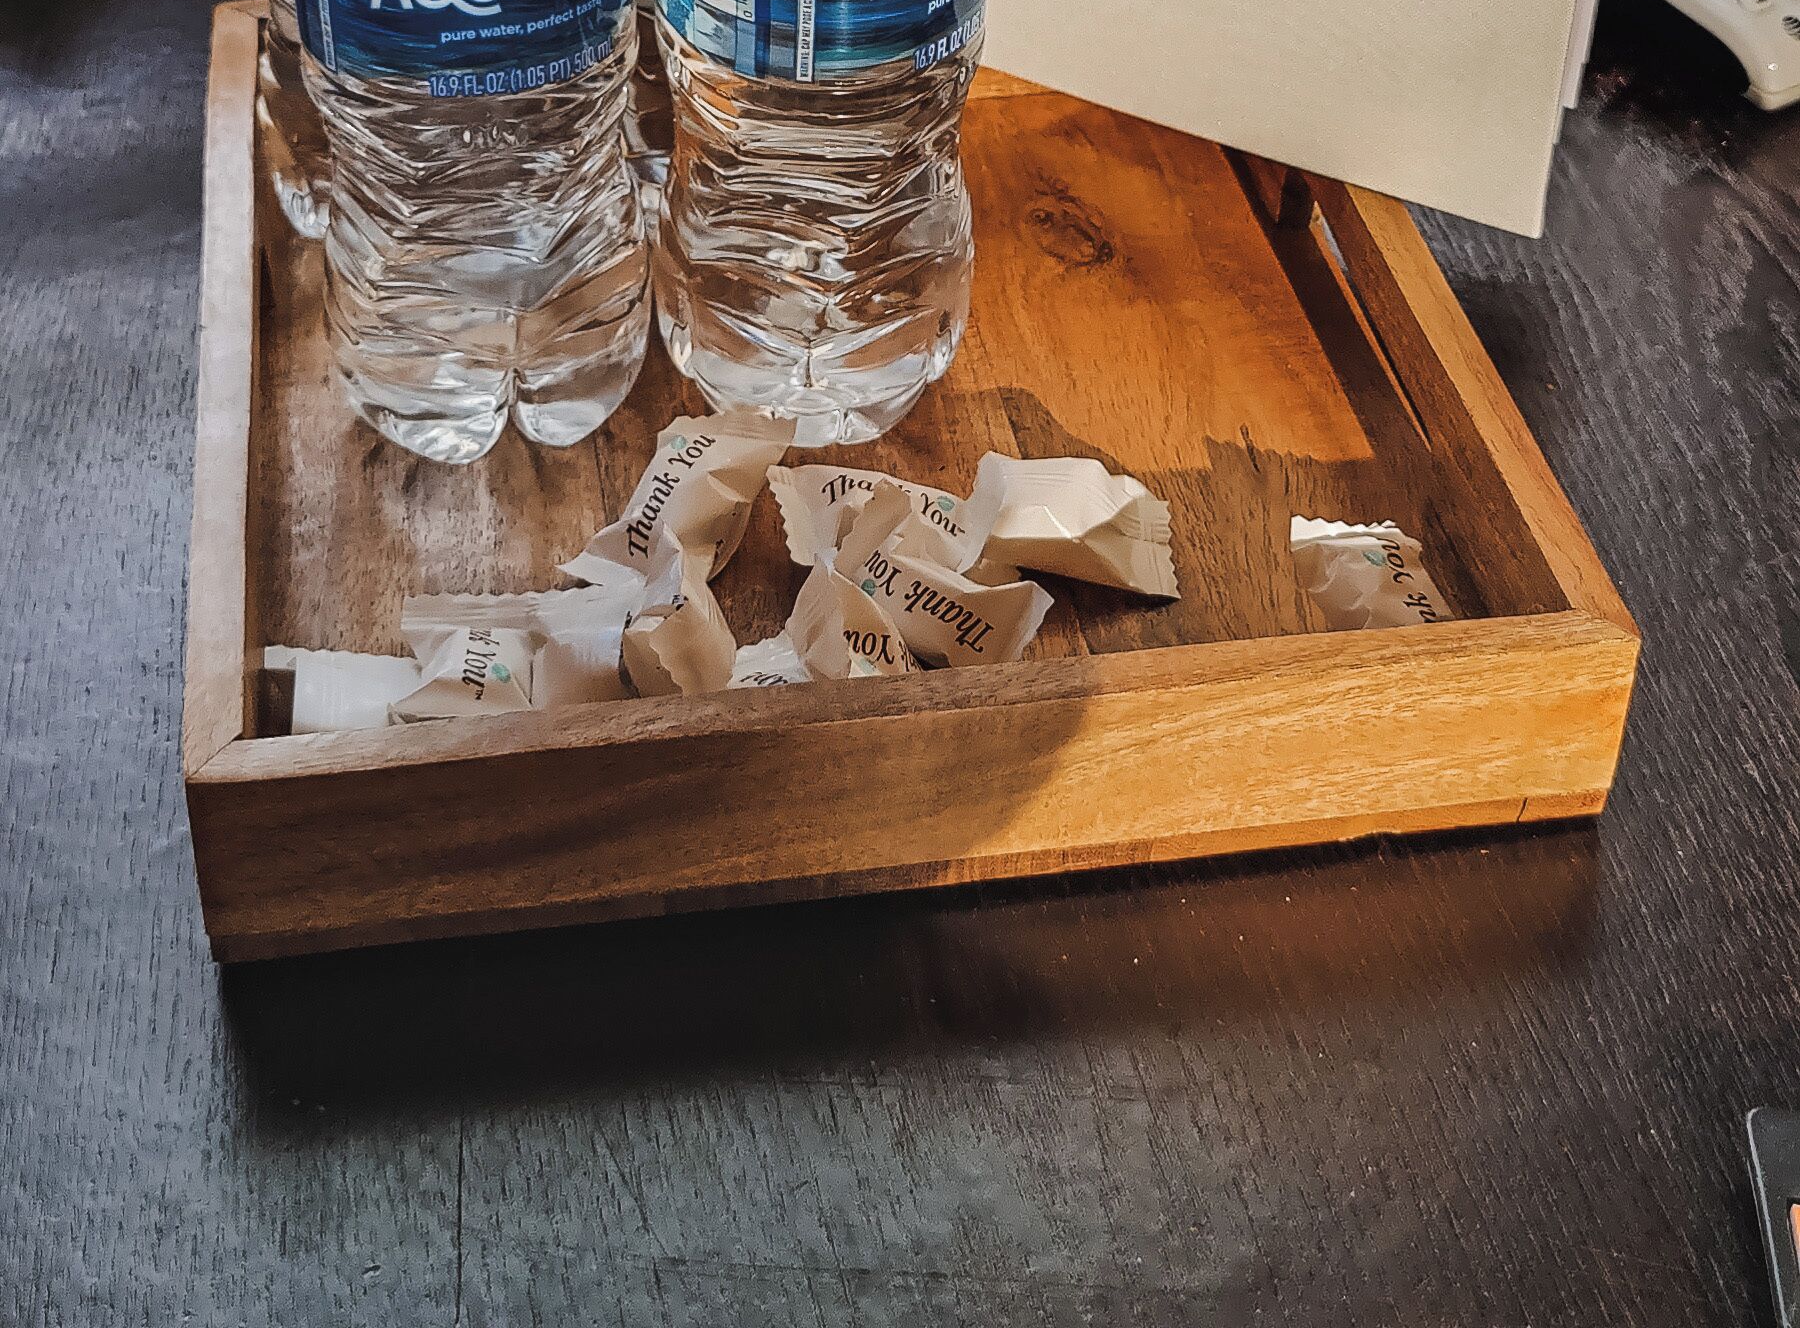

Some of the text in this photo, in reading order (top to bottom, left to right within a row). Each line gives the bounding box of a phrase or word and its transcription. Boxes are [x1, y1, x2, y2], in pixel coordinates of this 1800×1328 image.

[440, 30, 476, 44] pure
[479, 23, 525, 39] water,
[527, 10, 574, 34] perfect
[913, 43, 935, 71] 16.9
[950, 29, 962, 53] OZ
[430, 75, 459, 97] 16.9
[486, 72, 506, 94] OZ
[510, 64, 545, 92] (1.05
[550, 58, 572, 81] PT)
[574, 47, 596, 74] 500
[625, 433, 717, 559] Thank You
[864, 549, 995, 654] Thank You
[843, 629, 895, 665] You
